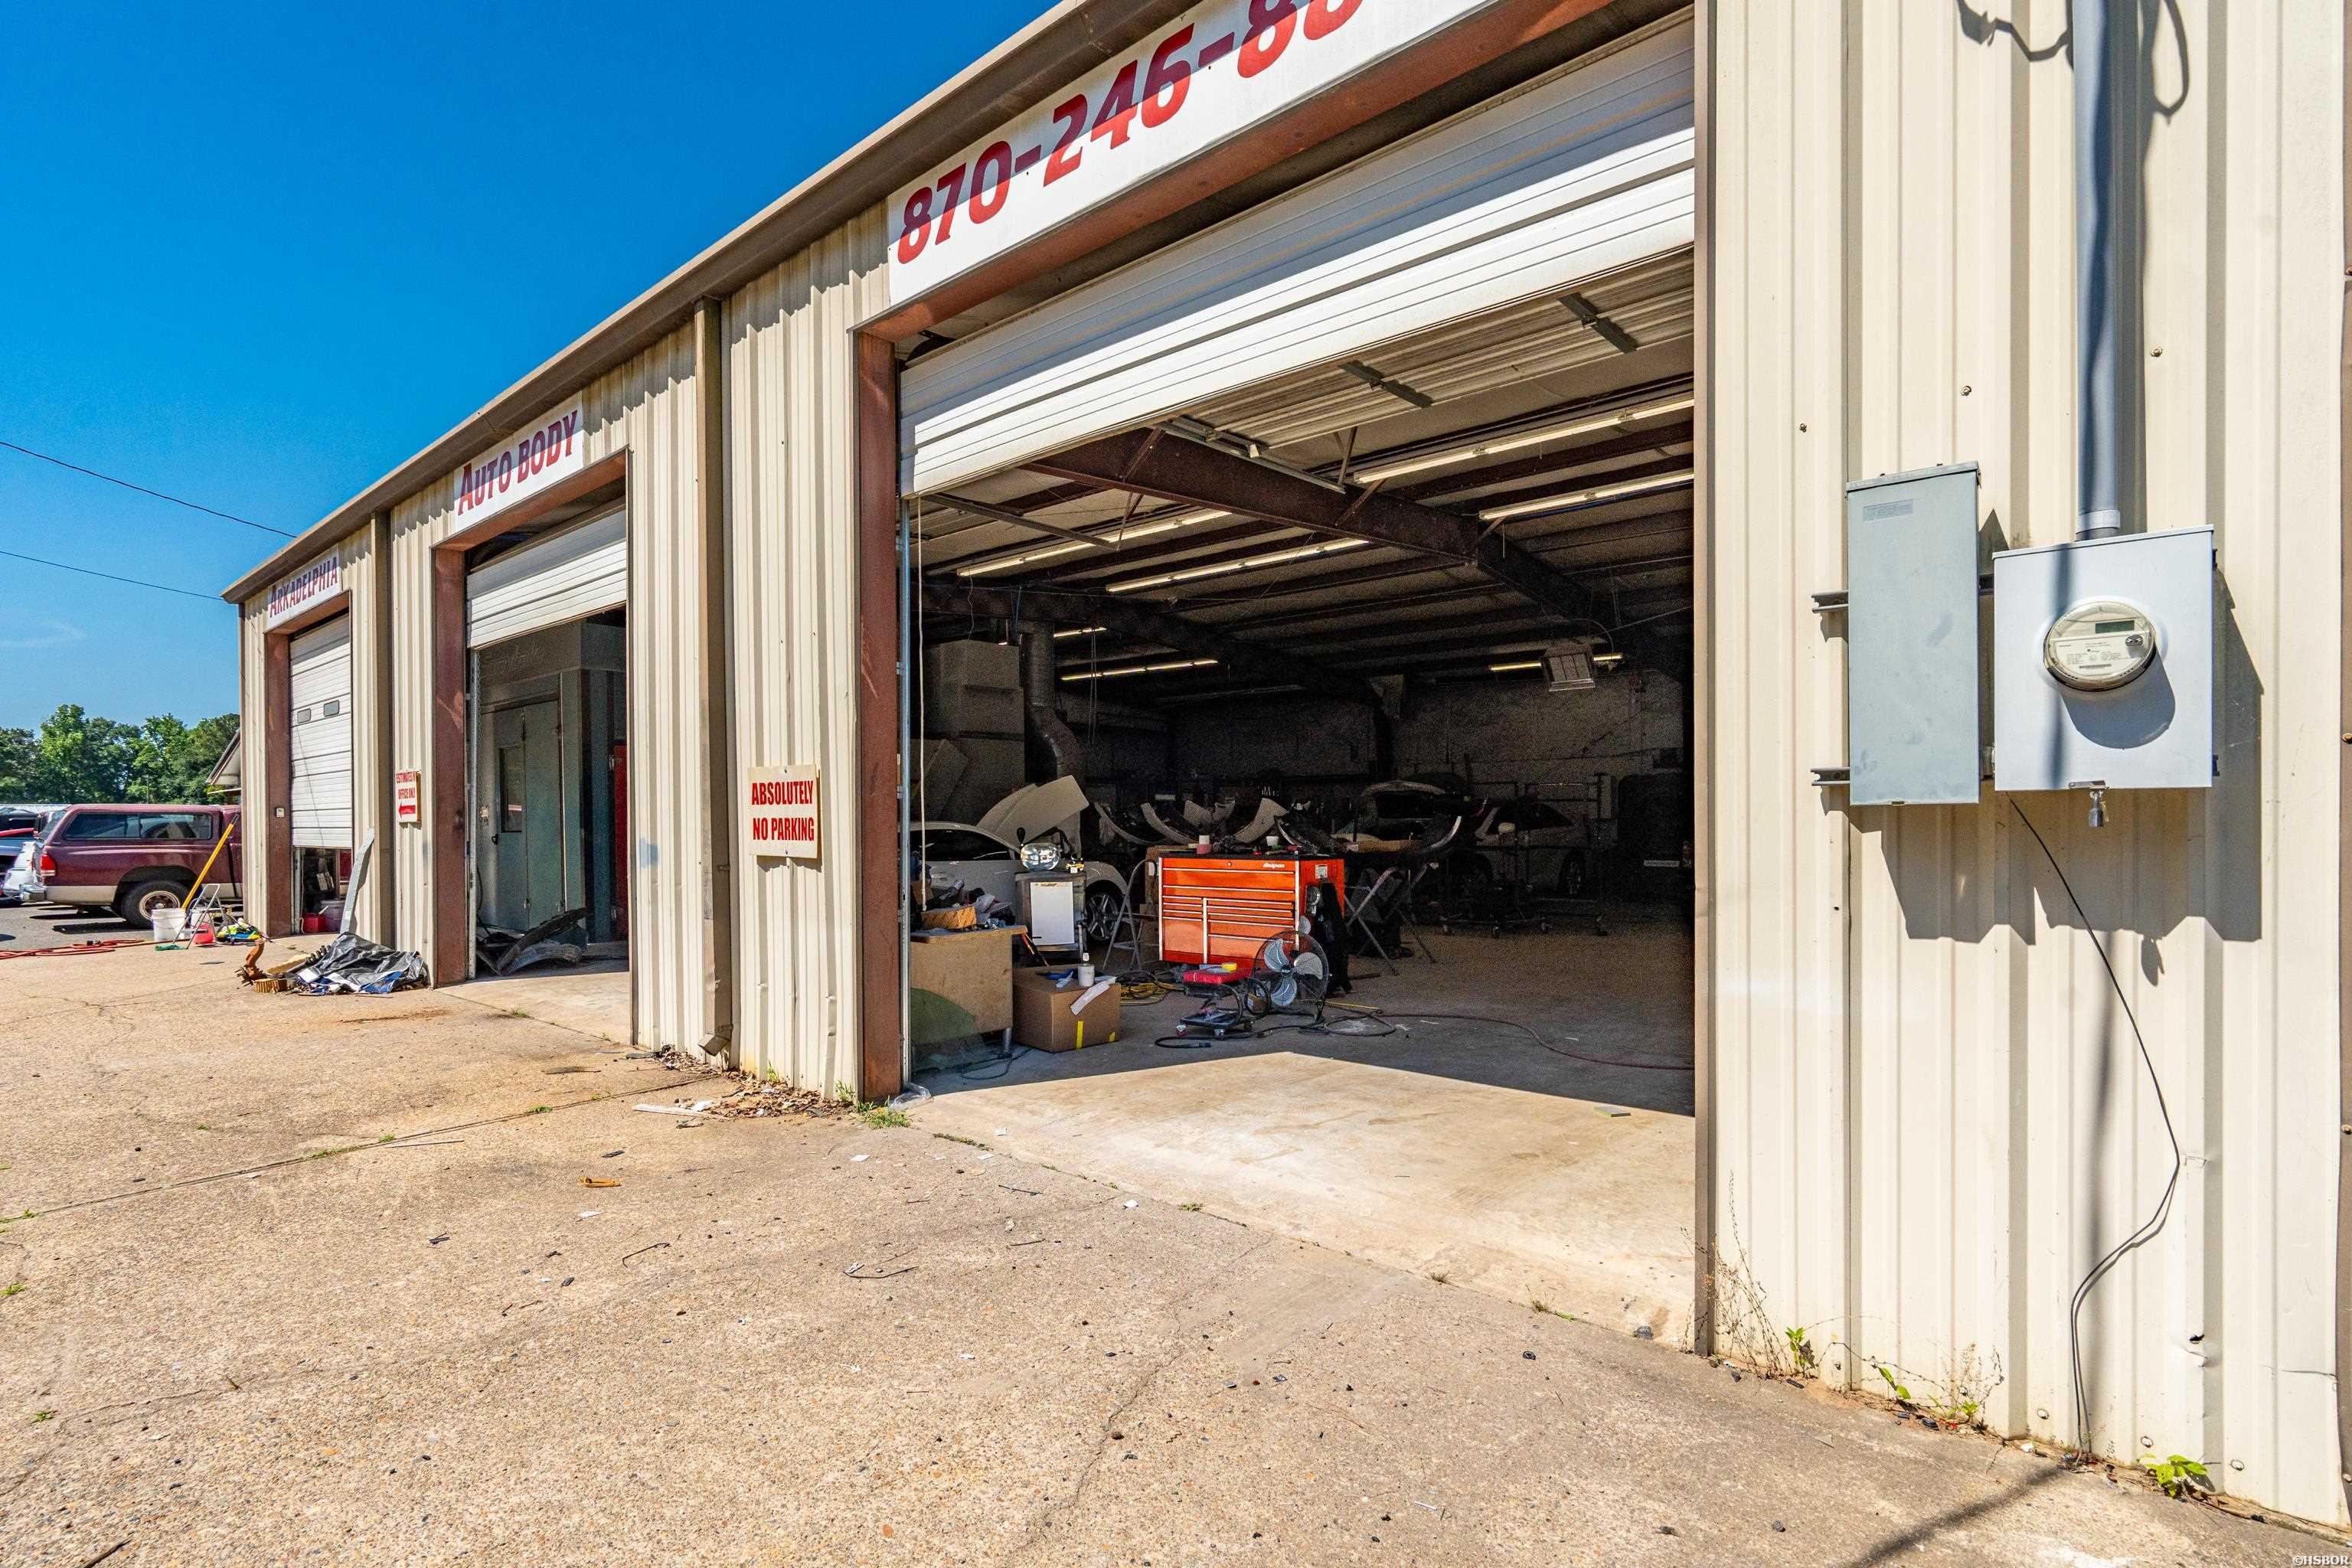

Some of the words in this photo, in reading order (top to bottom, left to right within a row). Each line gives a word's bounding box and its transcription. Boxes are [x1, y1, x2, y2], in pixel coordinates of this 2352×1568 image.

[518, 410, 577, 484] BODY
[270, 557, 338, 618] ARKADELPHIA
[751, 780, 813, 805] ABSOLUTELY
[753, 817, 768, 840] NO
[771, 817, 815, 841] PARKING
